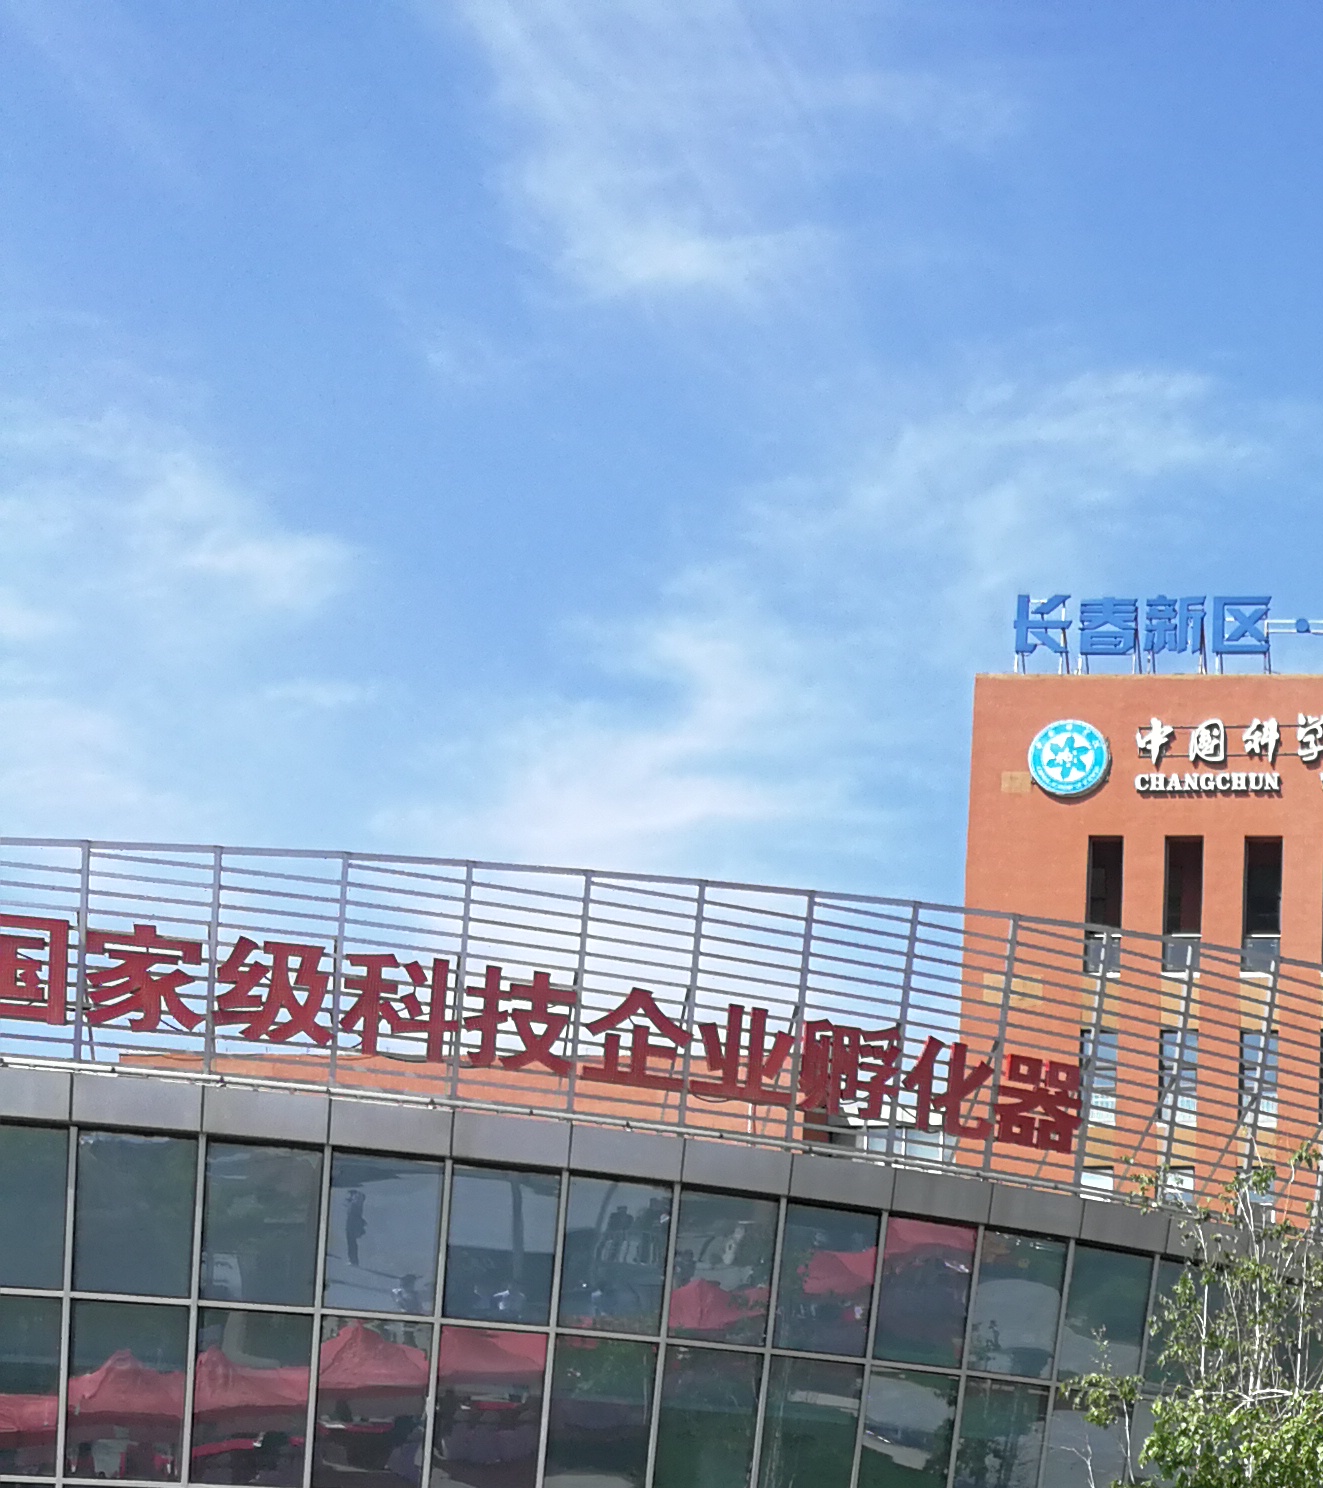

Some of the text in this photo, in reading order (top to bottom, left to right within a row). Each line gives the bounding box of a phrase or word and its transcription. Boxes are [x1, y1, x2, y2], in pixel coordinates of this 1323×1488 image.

[1134, 771, 1281, 792] CHANGCHUN
[0, 915, 1086, 1155] 国家级科技企业孵化器
